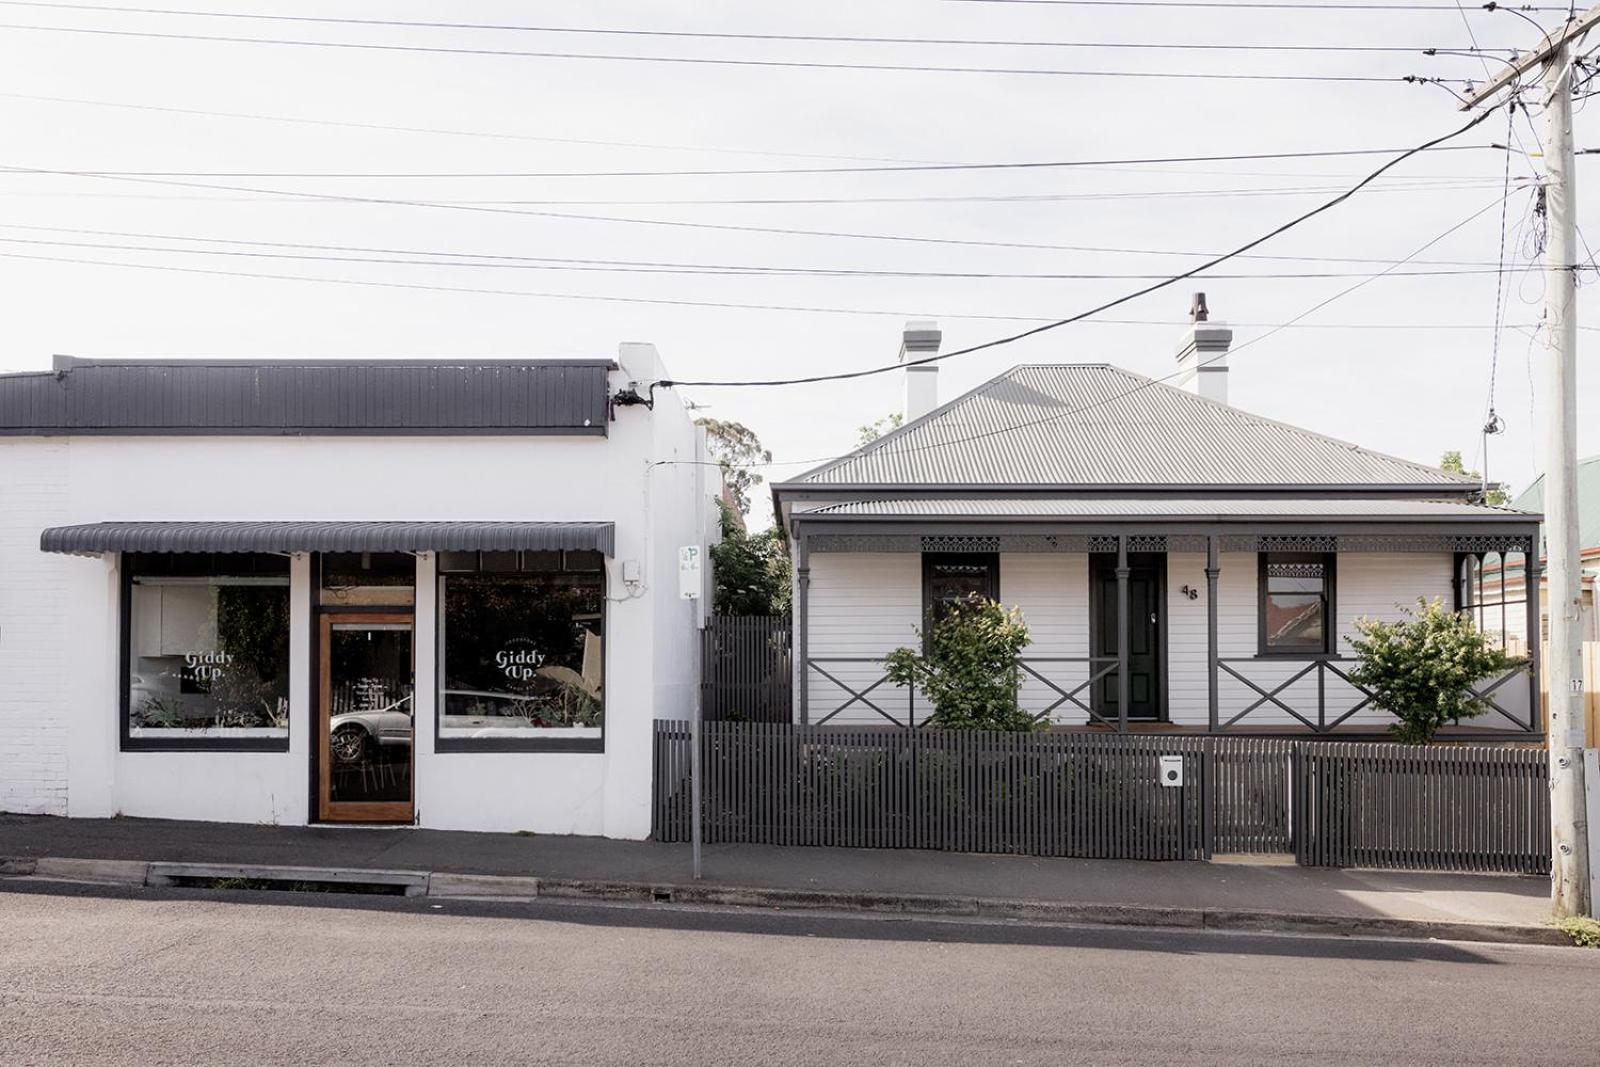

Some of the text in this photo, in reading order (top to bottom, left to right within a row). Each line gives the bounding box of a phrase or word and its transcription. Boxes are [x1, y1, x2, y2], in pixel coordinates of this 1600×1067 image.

[1180, 584, 1199, 601] 48
[185, 650, 234, 669] Giddy
[495, 649, 546, 669] Giddy
